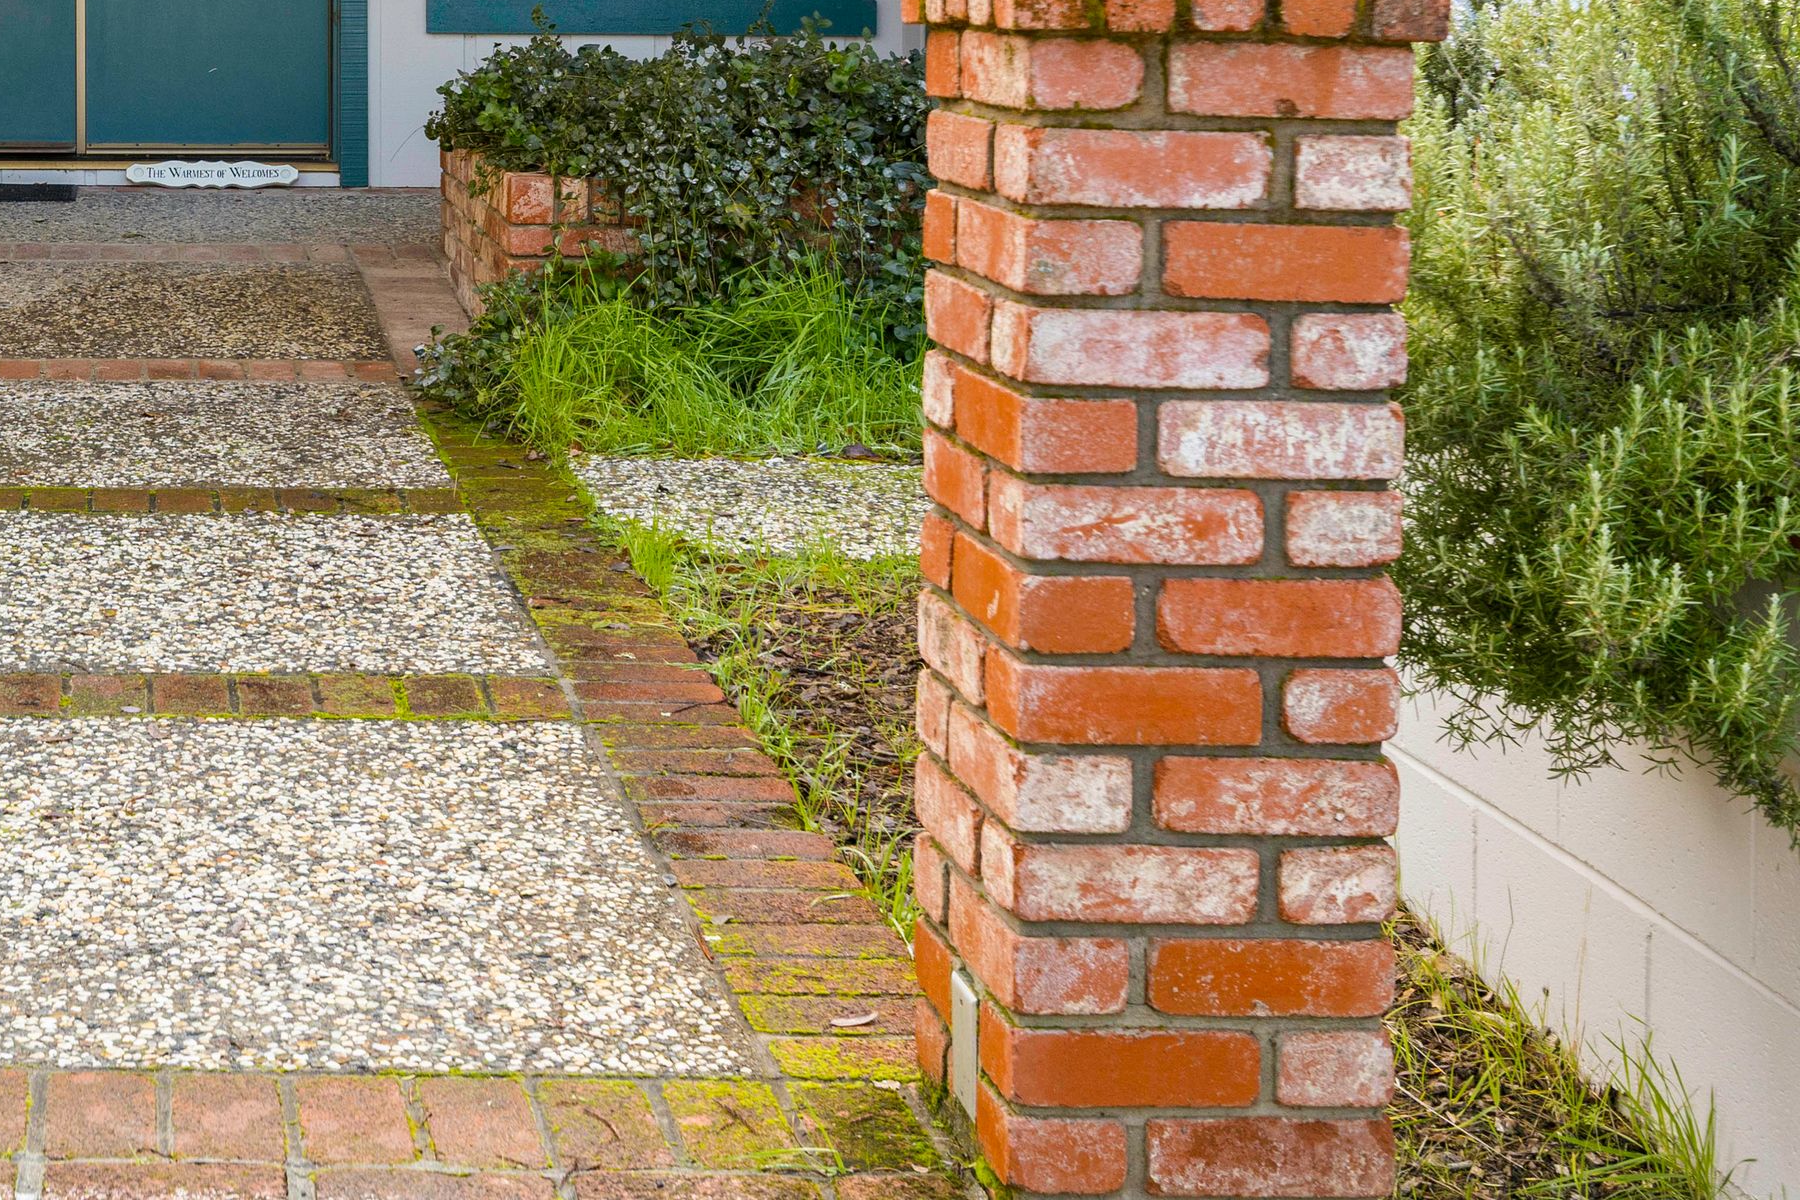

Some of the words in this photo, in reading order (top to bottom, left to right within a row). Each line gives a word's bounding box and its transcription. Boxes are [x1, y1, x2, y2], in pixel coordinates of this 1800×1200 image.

[146, 167, 166, 179] THE
[168, 167, 215, 179] WARMEST
[229, 167, 280, 179] WELCOMES
